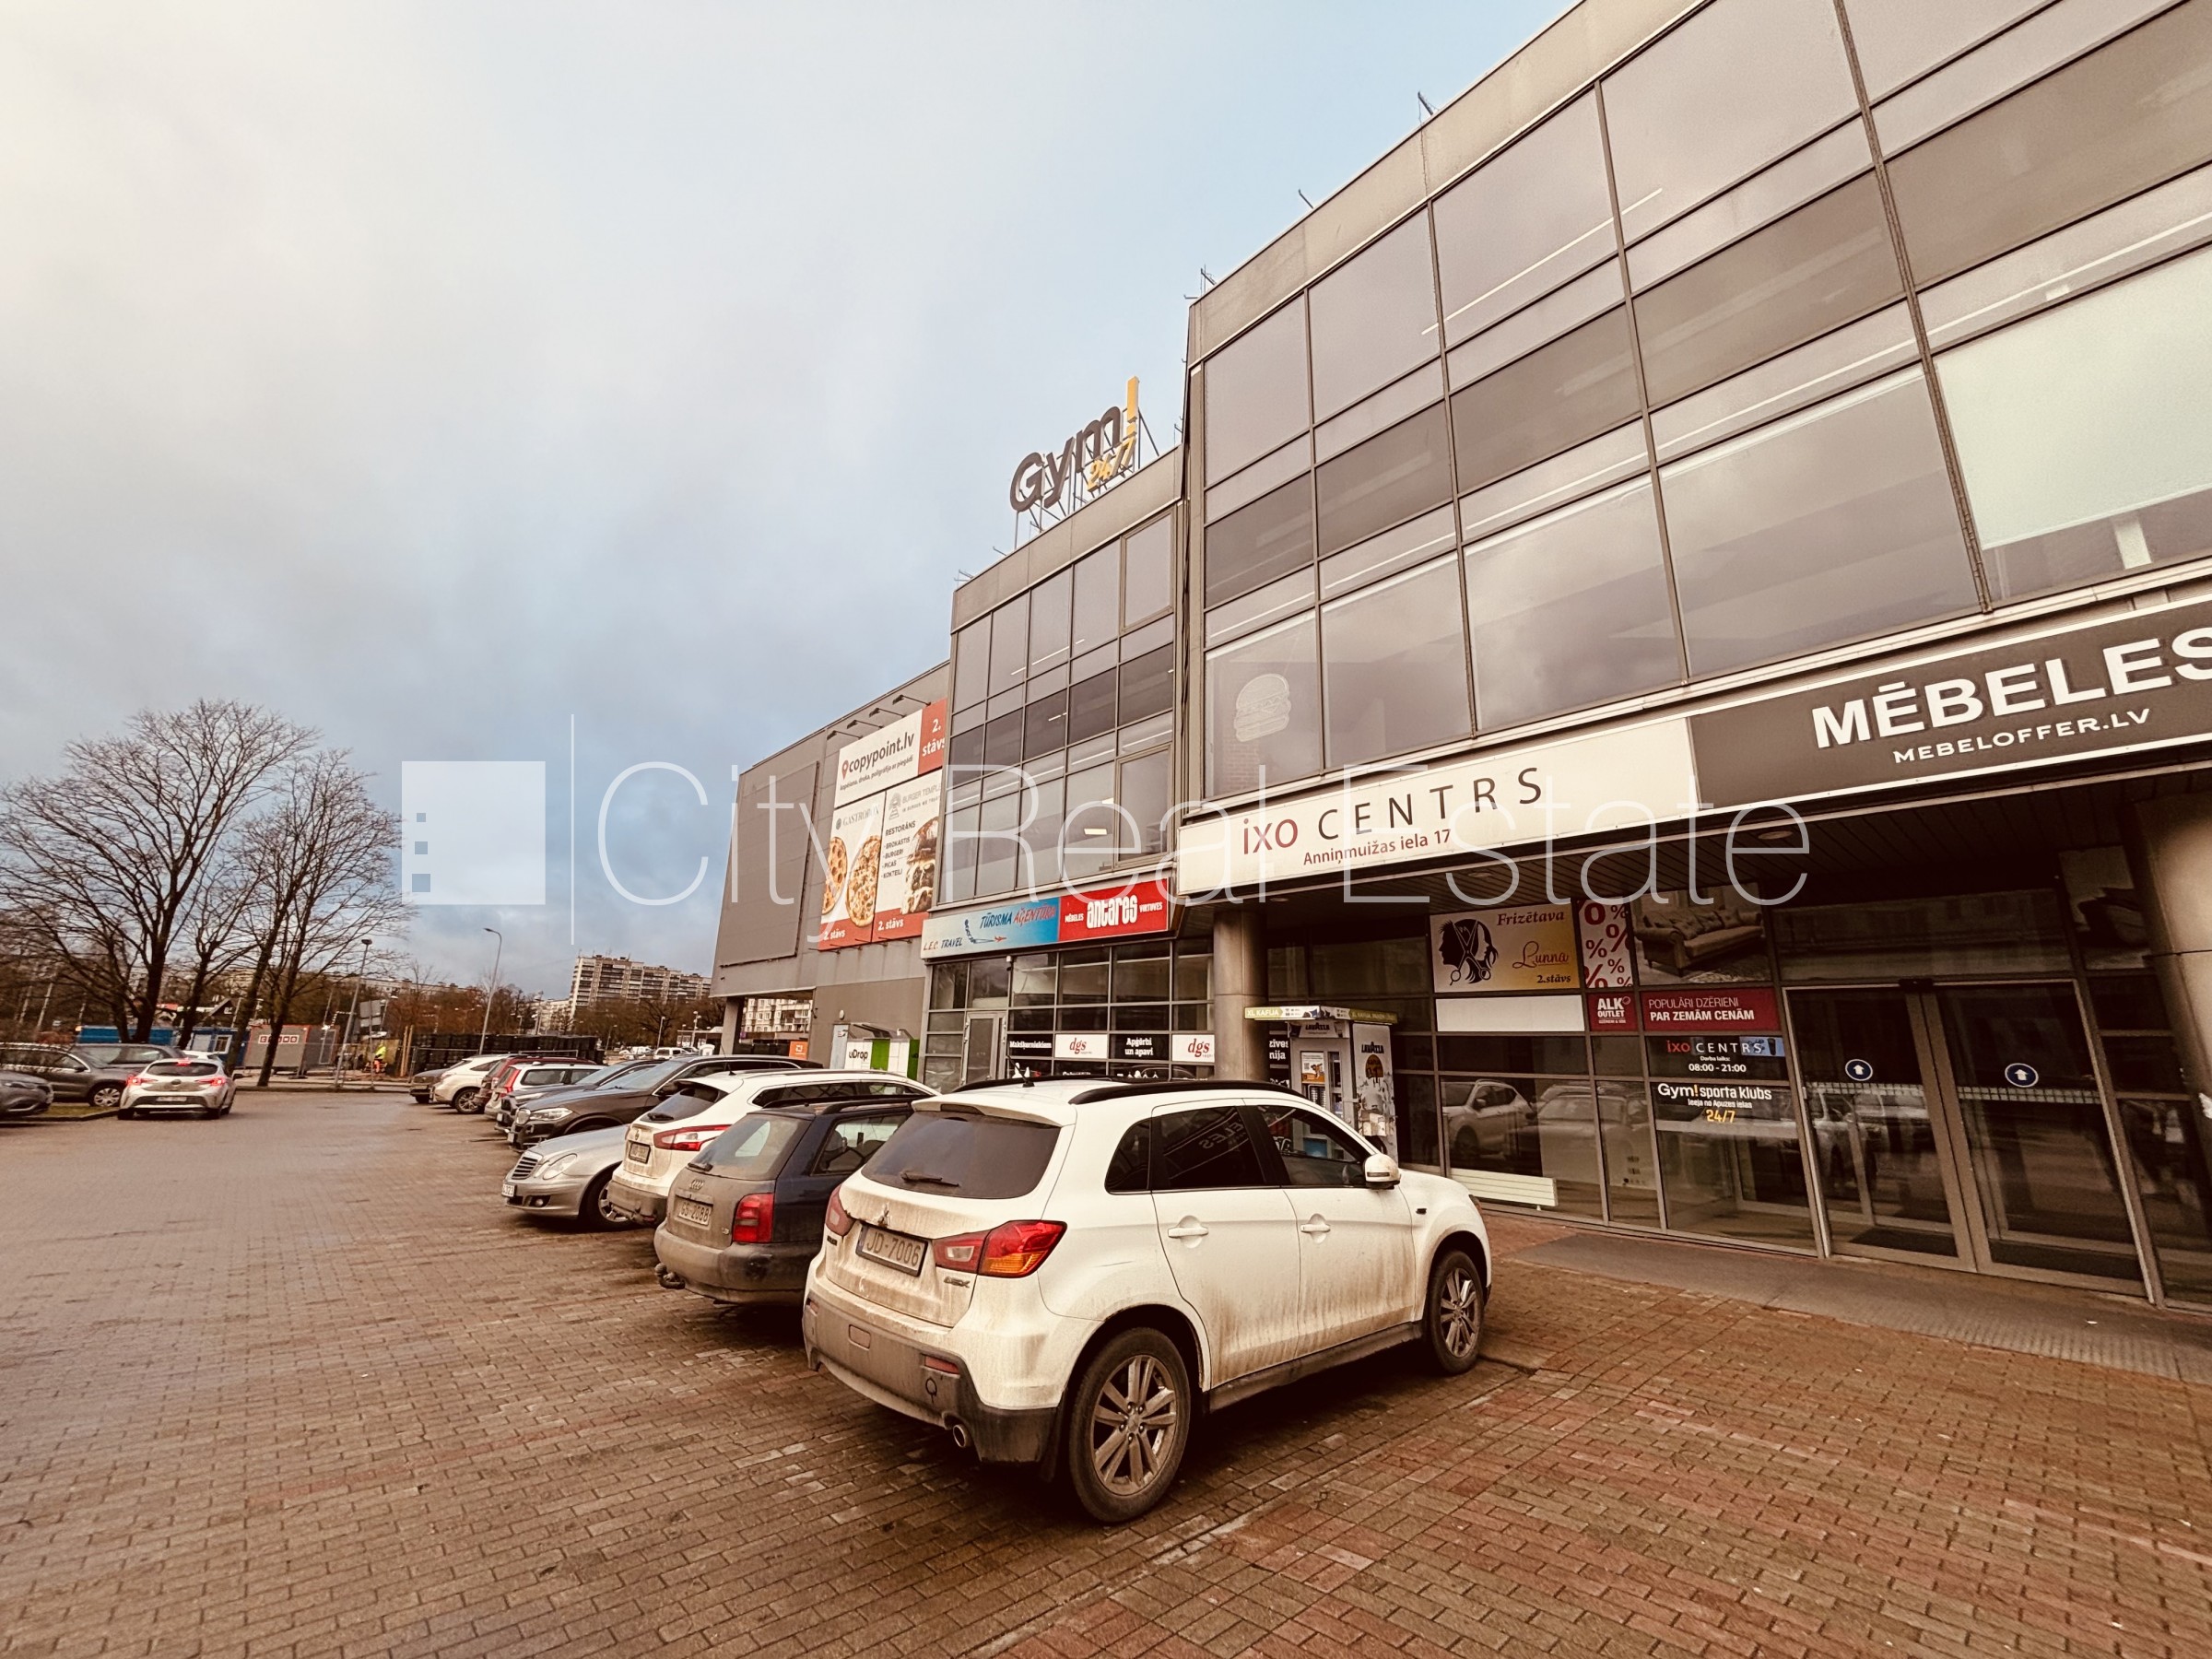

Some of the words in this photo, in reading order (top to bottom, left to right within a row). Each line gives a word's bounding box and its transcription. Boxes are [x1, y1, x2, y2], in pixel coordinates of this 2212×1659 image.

[1811, 626, 2212, 749] MĒBELES
[932, 719, 942, 733] 2.
[1893, 708, 2151, 764] MEBELOFFER.LV
[849, 732, 915, 772] copypoint.lv
[1318, 767, 1543, 841] CENTRS
[1302, 840, 1396, 866] Anniņmuižas
[1399, 832, 1429, 850] iela
[1433, 829, 1452, 846] 17
[1087, 895, 1138, 929] antares
[1497, 911, 1565, 926] Frizētava
[886, 917, 903, 930] stāvs
[980, 912, 1013, 929] TŪRISMA
[830, 928, 845, 939] stāvs
[941, 937, 963, 949] TRAVEL
[1512, 940, 1569, 969] Lunna
[1597, 997, 1624, 1010] ALK
[1649, 996, 1694, 1009] POPULĀRI
[1651, 1011, 1670, 1021] PAR
[1673, 1008, 1712, 1021] ZEMĀM
[1714, 1007, 1755, 1020] CENĀM
[1069, 1037, 1088, 1054] dgs
[1135, 1047, 1154, 1057] apavi
[1187, 1038, 1210, 1058] dgs
[1695, 1042, 1762, 1053] CENTRS
[848, 1049, 869, 1062] uDrop
[1688, 1063, 1714, 1072] 08:00
[1721, 1064, 1747, 1073] 21:00
[1700, 1086, 1737, 1100] sporta
[1739, 1086, 1772, 1100] klubs
[1706, 1109, 1735, 1124] 24/7
[866, 1230, 922, 1267] JD-7006
